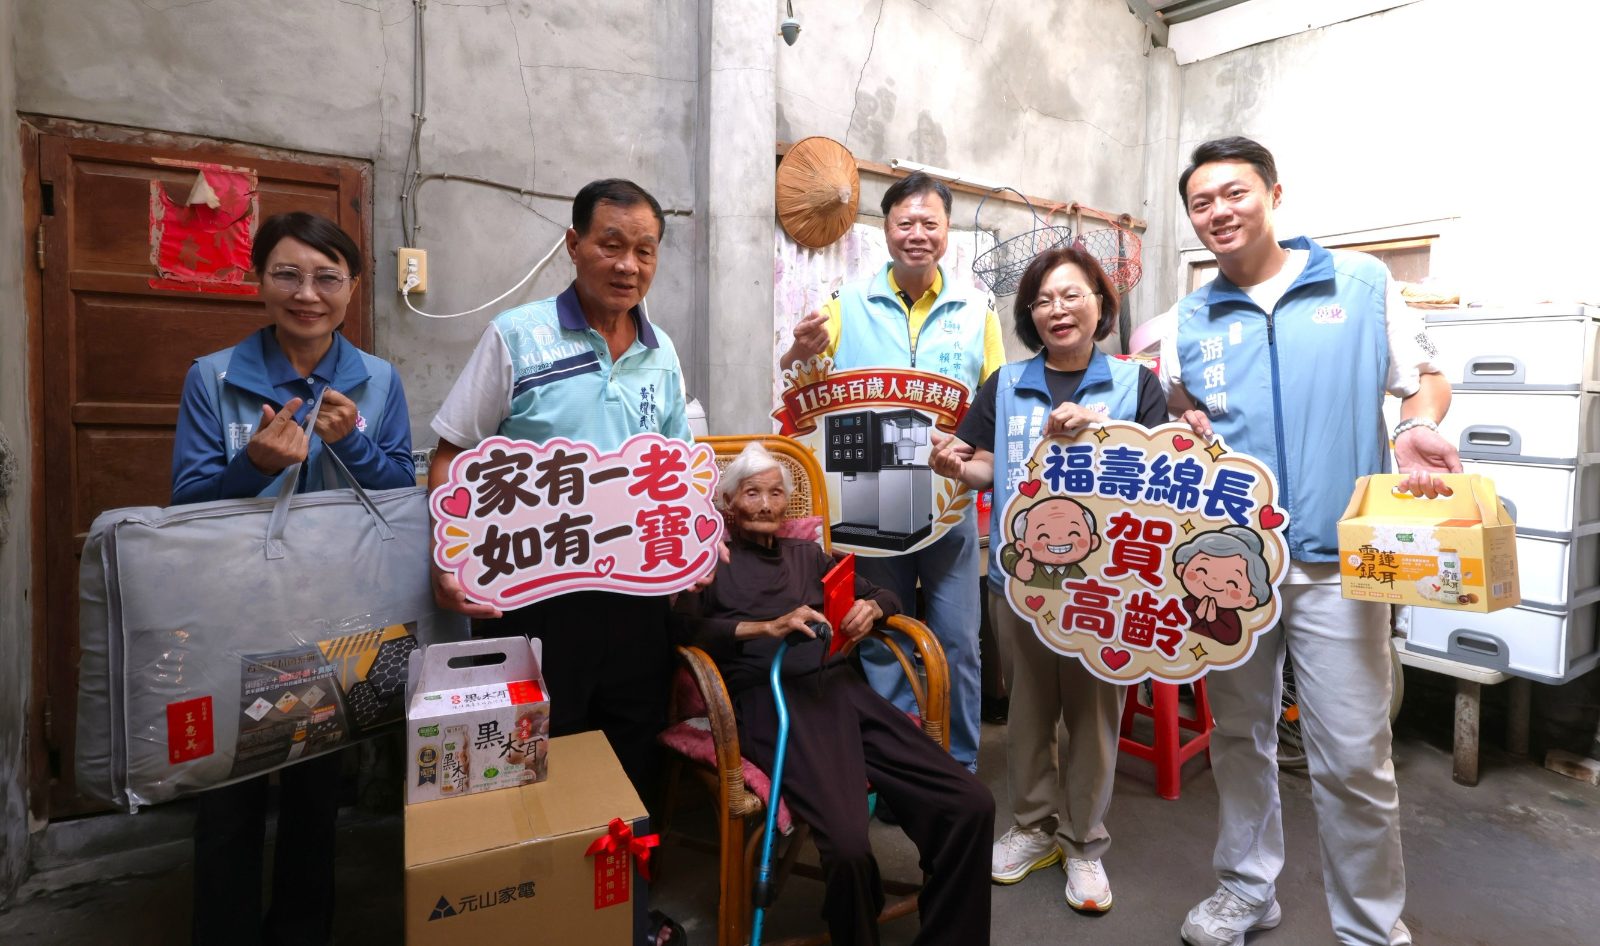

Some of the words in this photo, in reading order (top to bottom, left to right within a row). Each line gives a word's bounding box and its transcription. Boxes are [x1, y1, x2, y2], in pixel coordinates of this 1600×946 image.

[521, 341, 585, 366] YUANLIN
[1200, 336, 1227, 417] 游筑凱
[796, 376, 962, 414] 115年百歲人瑞表揚
[465, 443, 689, 518] 家有一老
[1043, 445, 1256, 526] 福壽綿長
[473, 504, 692, 586] 如有一寶
[1103, 511, 1173, 587] 賀
[1061, 579, 1184, 657] 高齡
[442, 752, 466, 792] 黑木耳
[474, 720, 544, 760] 黑木耳
[459, 881, 536, 914] 元山家電
